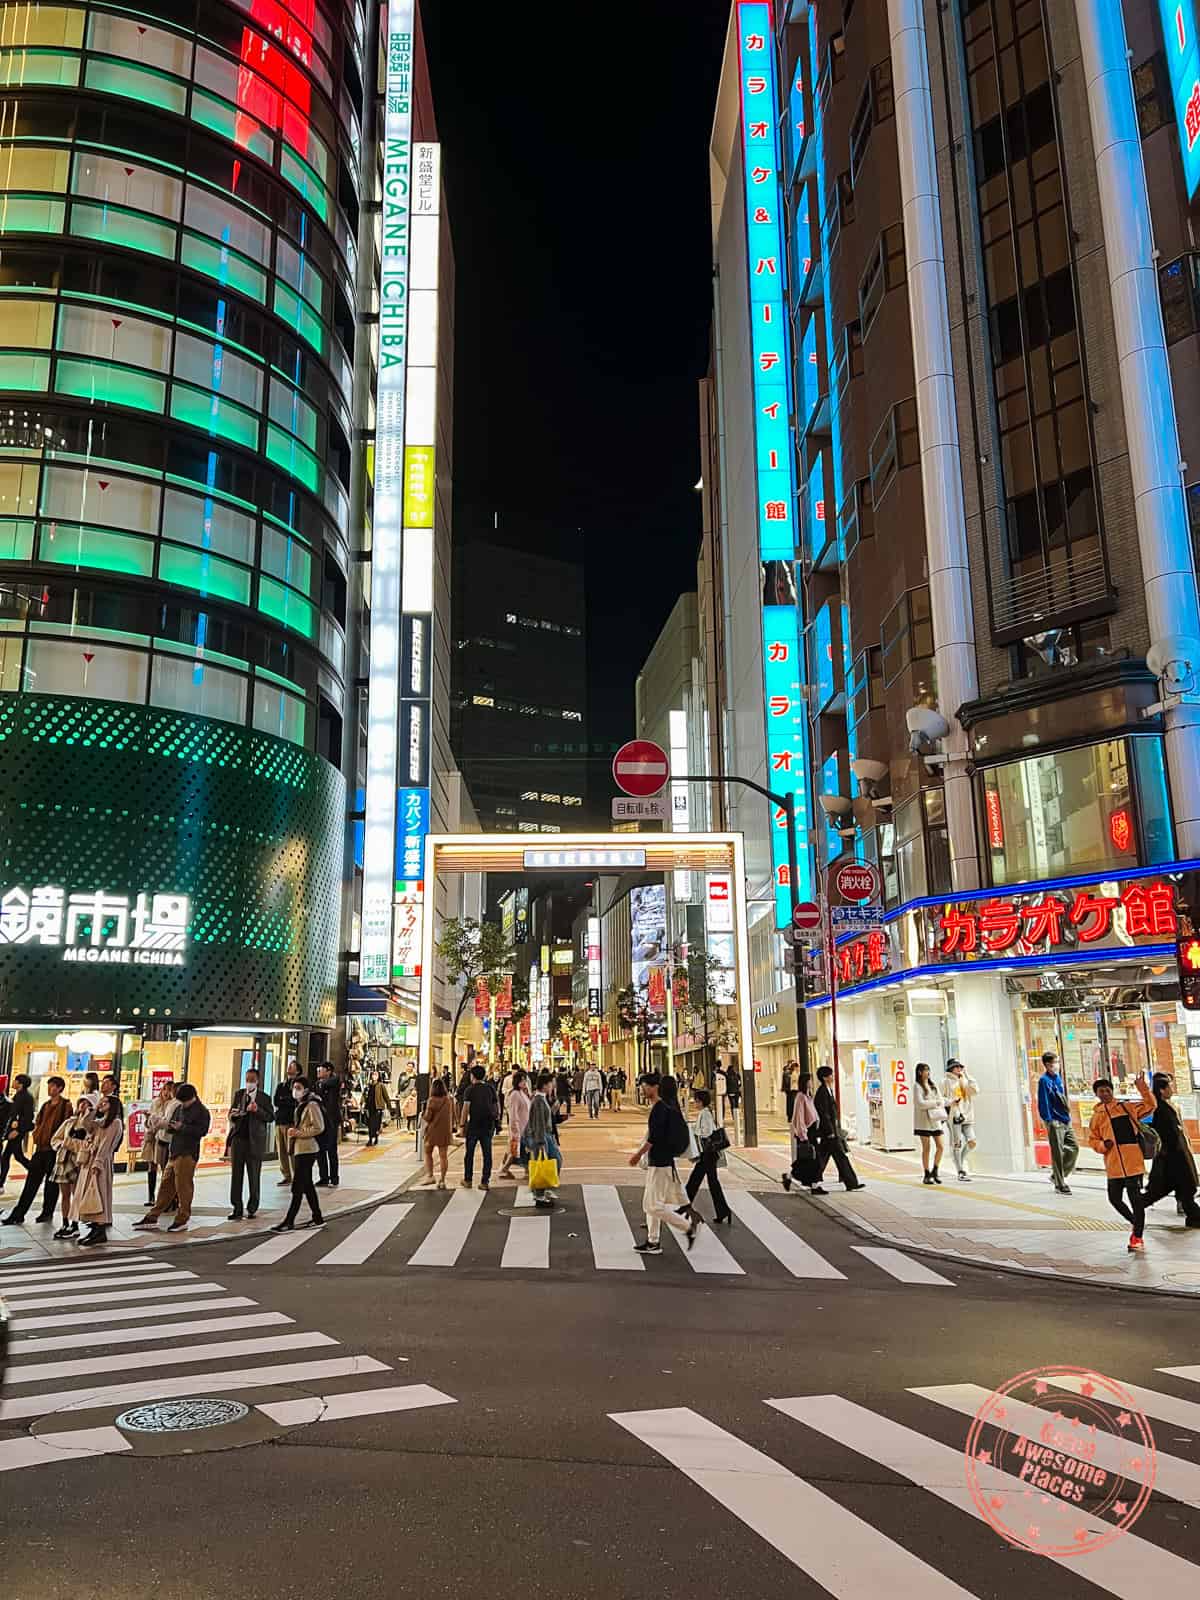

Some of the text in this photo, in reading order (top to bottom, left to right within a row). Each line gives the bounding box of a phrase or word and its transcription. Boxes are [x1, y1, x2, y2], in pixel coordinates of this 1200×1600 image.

[380, 138, 408, 369] MEGANE ICHIBA
[840, 876, 872, 891] 消火栓
[940, 881, 1178, 953] カラオケ館
[62, 948, 185, 965] MEGANE ICHIBA
[896, 1060, 910, 1105] DyDo
